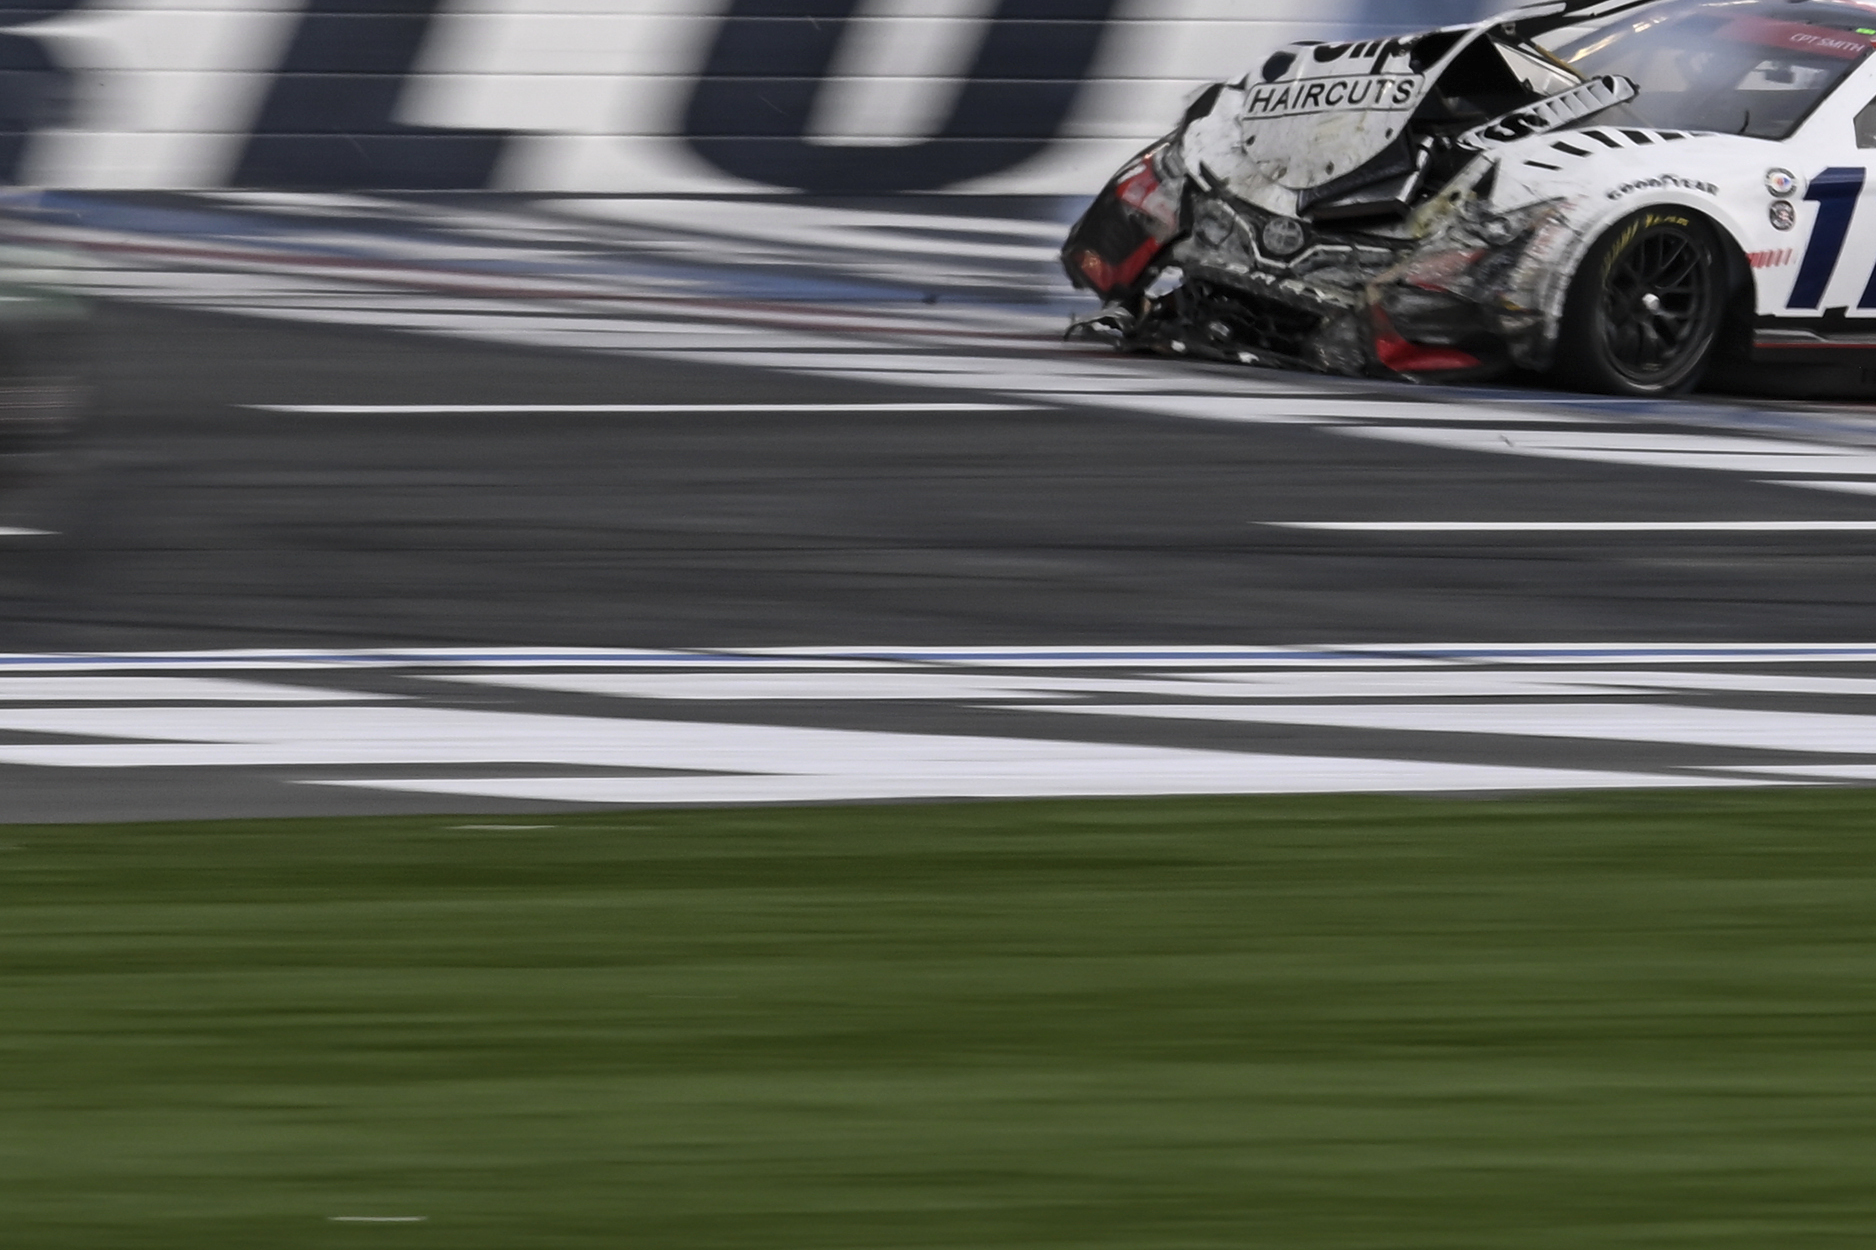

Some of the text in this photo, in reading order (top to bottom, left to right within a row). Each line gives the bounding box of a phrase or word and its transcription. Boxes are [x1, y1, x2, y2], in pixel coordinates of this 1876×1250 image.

[1818, 37, 1866, 52] SMITH
[1248, 78, 1416, 114] HAIRCUTS
[1604, 173, 1720, 201] GOODYEAR
